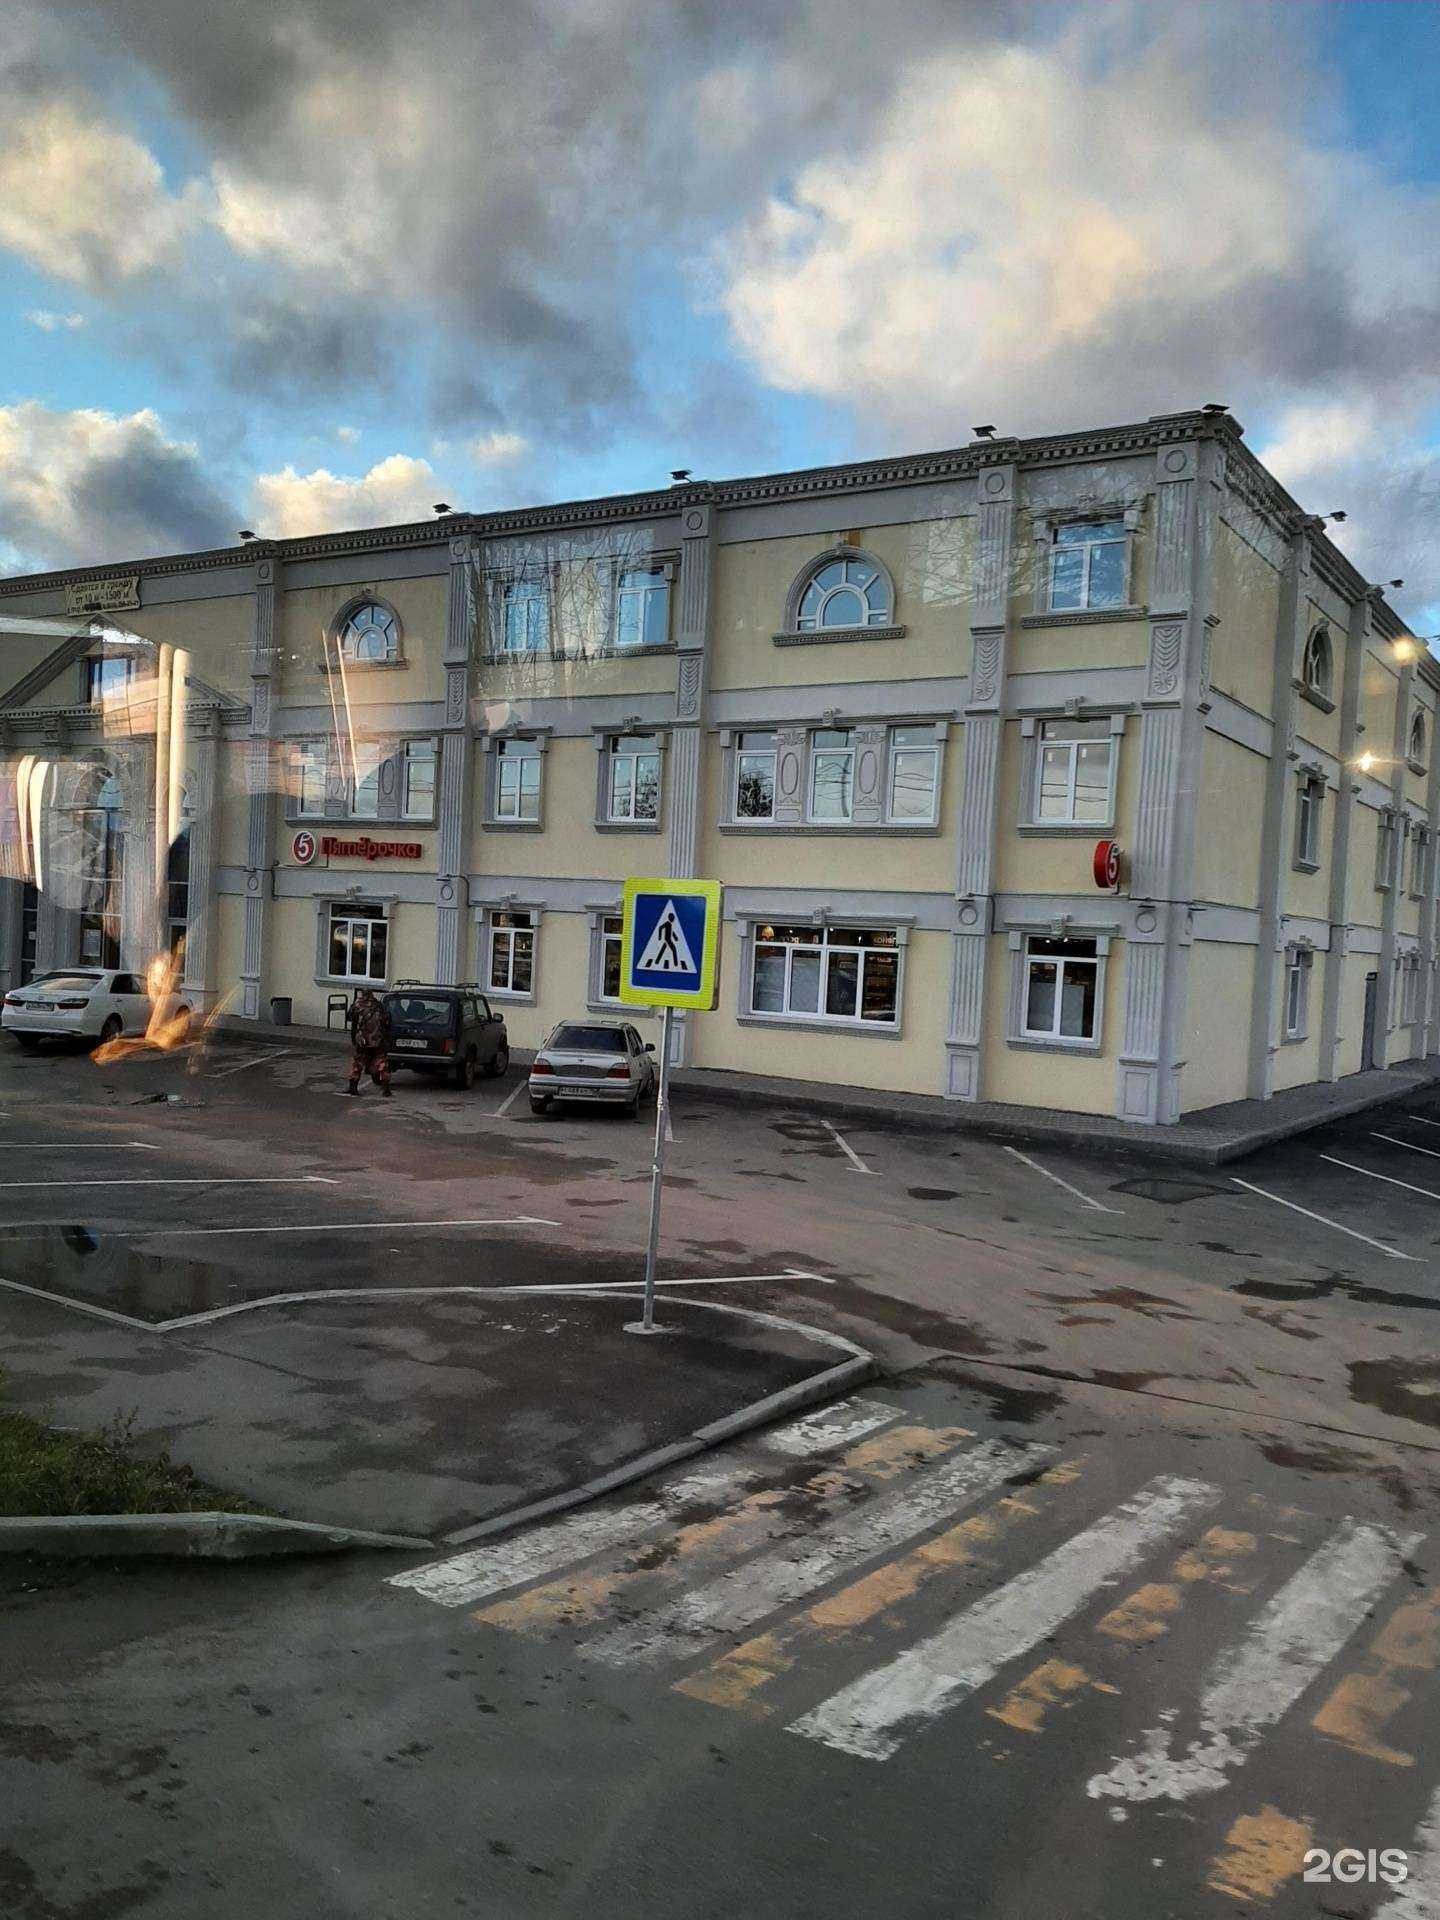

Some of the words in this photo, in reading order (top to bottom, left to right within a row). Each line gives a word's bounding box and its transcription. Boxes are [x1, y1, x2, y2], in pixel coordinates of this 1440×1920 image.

[299, 832, 312, 858] 5
[322, 837, 421, 860] Пятёрочка
[1109, 845, 1119, 880] 5
